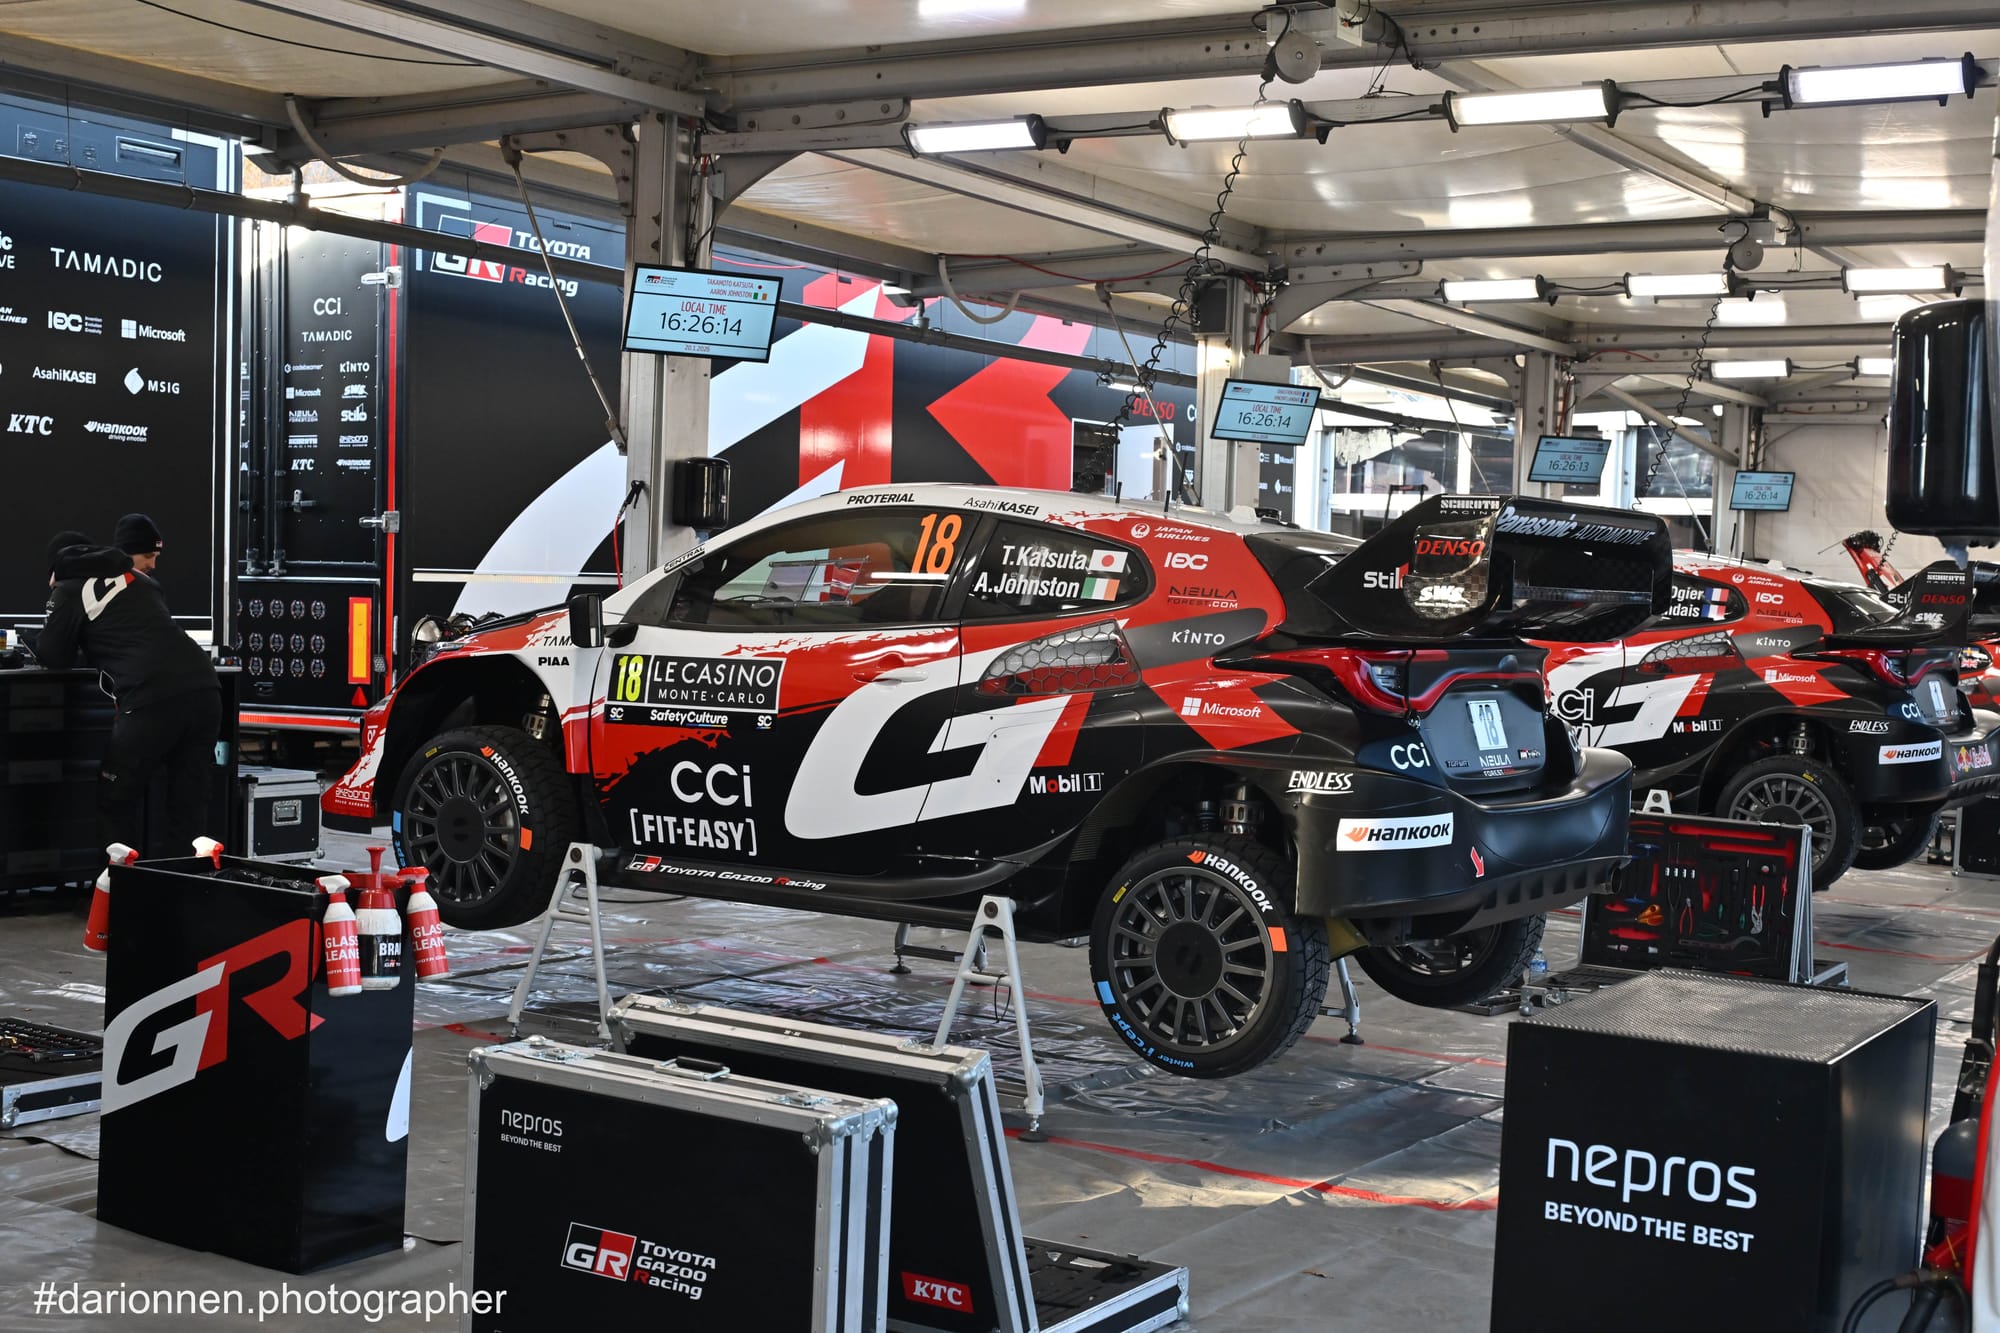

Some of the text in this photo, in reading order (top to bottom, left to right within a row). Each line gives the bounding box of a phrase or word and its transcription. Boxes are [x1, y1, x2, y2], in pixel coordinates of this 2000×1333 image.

[515, 231, 591, 260] TOYOTA
[51, 247, 162, 282] TAMADIC
[509, 266, 579, 297] Racing
[681, 301, 727, 315] LOCAL TIME
[139, 324, 186, 342] Microsoft
[661, 312, 742, 336] 16:26:14
[301, 330, 352, 342] TAMADIC
[33, 366, 96, 385] AsahiKASEI
[148, 380, 180, 394] MSIG
[1132, 397, 1176, 420] DENSO
[1252, 404, 1282, 414] LOCAL TIME
[7, 413, 54, 435] KTC
[1238, 412, 1292, 428] 16:26:14
[291, 459, 315, 471] KTC
[1548, 460, 1590, 472] 16:26:13
[847, 493, 915, 505] PROTERIAL
[1745, 490, 1779, 500] 16:26:14
[963, 497, 1039, 515] AsahiKASEI
[1154, 526, 1193, 534] JAPAN
[1496, 506, 1656, 545] Panasonic AUTOMOTIVE
[912, 513, 962, 573] 18
[1154, 533, 1211, 542] AIRLINES
[1416, 539, 1486, 557] DENSO
[1363, 567, 1404, 589] Stil
[1921, 594, 1966, 605] DENSO
[538, 656, 569, 666] PIAA
[616, 655, 645, 702] 18
[653, 660, 775, 687] LE CASINO
[1778, 672, 1816, 683] Microsoft
[610, 707, 624, 720] SC
[650, 709, 728, 725] SafetyCulture
[1202, 703, 1262, 718] Microsoft
[757, 715, 772, 727] SC
[1673, 720, 1708, 733] Mobil
[1849, 720, 1890, 733] ENDLESS
[1896, 746, 1940, 759] Hankook
[491, 752, 529, 815] Hankook
[1030, 774, 1100, 795] Mobil 1
[1288, 771, 1354, 791] ENDLESS
[1367, 822, 1450, 842] Hankook
[659, 865, 715, 877] TOYOTA
[718, 871, 773, 884] GAZOO
[774, 877, 826, 891] Racing
[1203, 853, 1273, 913] Hankook
[1157, 1054, 1194, 1068] winter
[501, 1109, 563, 1136] nepros
[500, 1133, 562, 1152] BEYOND THE BEST
[1547, 1138, 1757, 1209] nepros
[1544, 1201, 1754, 1252] BEYOND THE BEST
[566, 1242, 628, 1277] GR
[640, 1240, 716, 1269] TOYOTA
[635, 1256, 707, 1282] GAZOO
[633, 1269, 703, 1300] Racing
[913, 1280, 962, 1305] KTC
